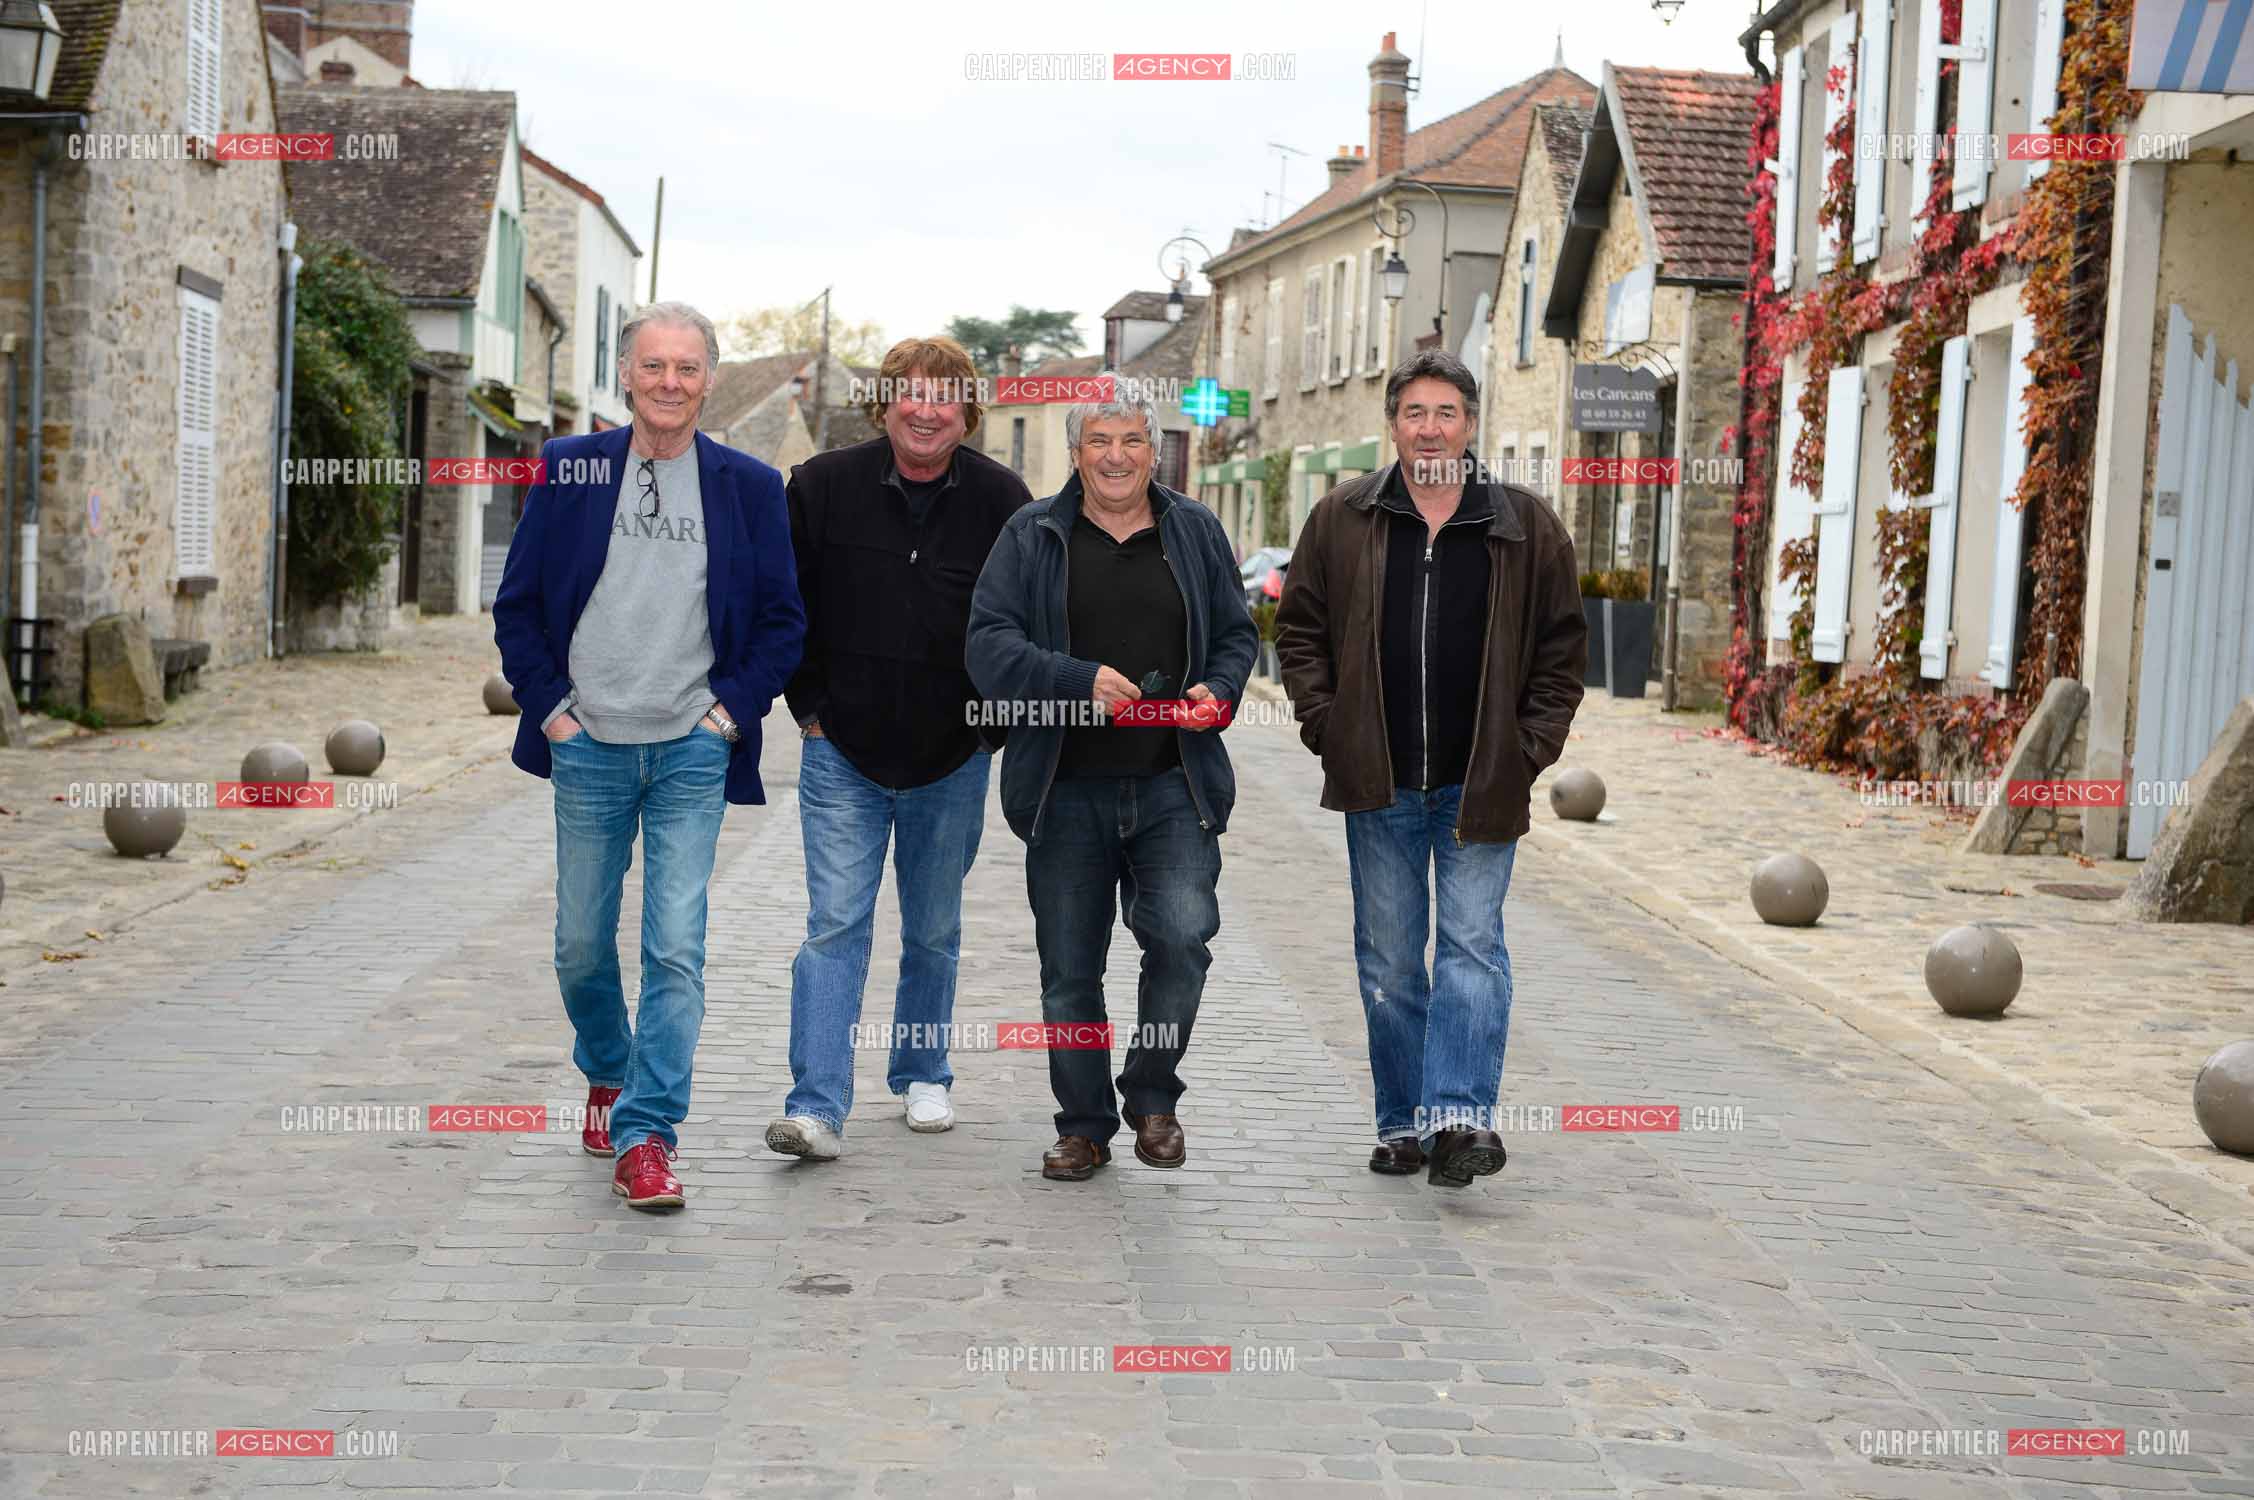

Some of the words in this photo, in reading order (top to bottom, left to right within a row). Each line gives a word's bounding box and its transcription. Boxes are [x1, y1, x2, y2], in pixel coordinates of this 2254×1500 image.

[1574, 386, 1596, 401] Les
[1597, 386, 1656, 403] Cancans
[611, 511, 706, 545] ANAR
